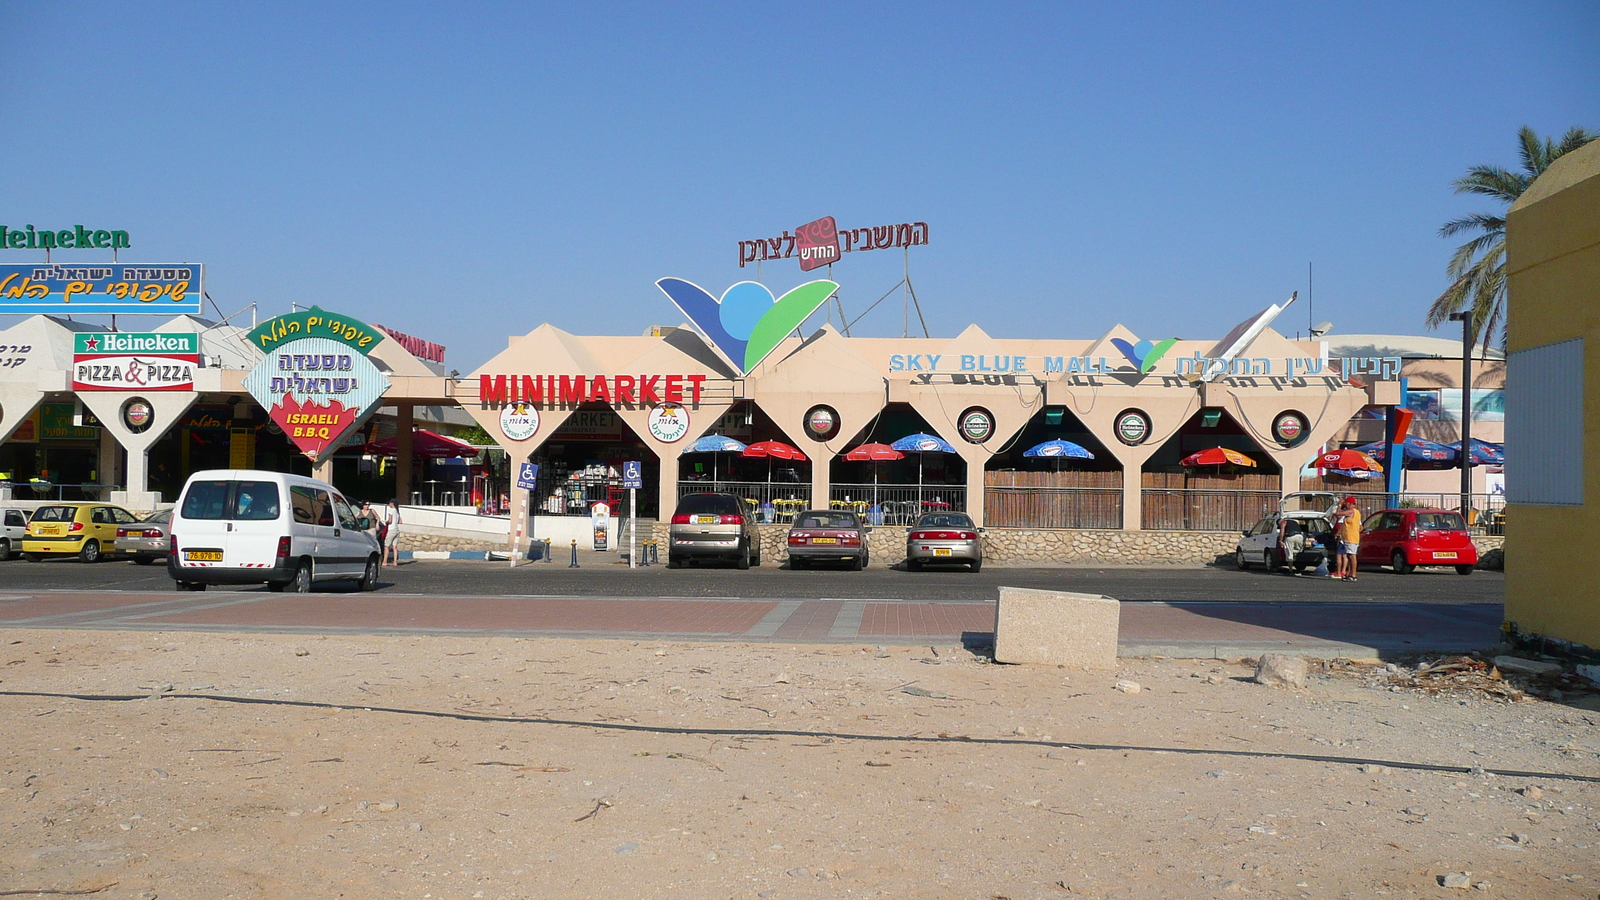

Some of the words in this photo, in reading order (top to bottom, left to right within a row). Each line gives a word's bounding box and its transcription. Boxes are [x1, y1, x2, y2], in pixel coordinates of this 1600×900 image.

[738, 230, 797, 268] לצרכן
[838, 222, 929, 254] המשביר
[801, 245, 835, 260] החדש
[32, 264, 113, 281] ישראלית
[123, 267, 191, 281] מסעדה
[0, 272, 50, 299] המל
[63, 281, 94, 304] ים
[105, 281, 190, 303] שיפודי
[259, 319, 301, 347] המלח
[306, 316, 323, 334] ים
[328, 319, 373, 348] שיפודי
[103, 334, 190, 351] Heineken
[78, 365, 123, 381] PIZZA
[125, 360, 147, 385] &
[147, 365, 193, 381] PIZZA
[278, 353, 354, 371] מסעדה
[890, 354, 942, 372] SKY
[960, 355, 1027, 373] BLUE
[1045, 356, 1114, 373] MALL
[1176, 351, 1272, 375] התכלת
[1286, 357, 1323, 381] עין
[1341, 356, 1401, 380] קניון
[270, 371, 359, 394] ישראלית
[480, 374, 706, 402] MINIMARKET
[286, 413, 339, 426] ISRAELI
[509, 416, 529, 424] mix
[658, 416, 679, 424] mix
[293, 427, 330, 440] B.B.Q
[651, 423, 686, 440] מינימרקט
